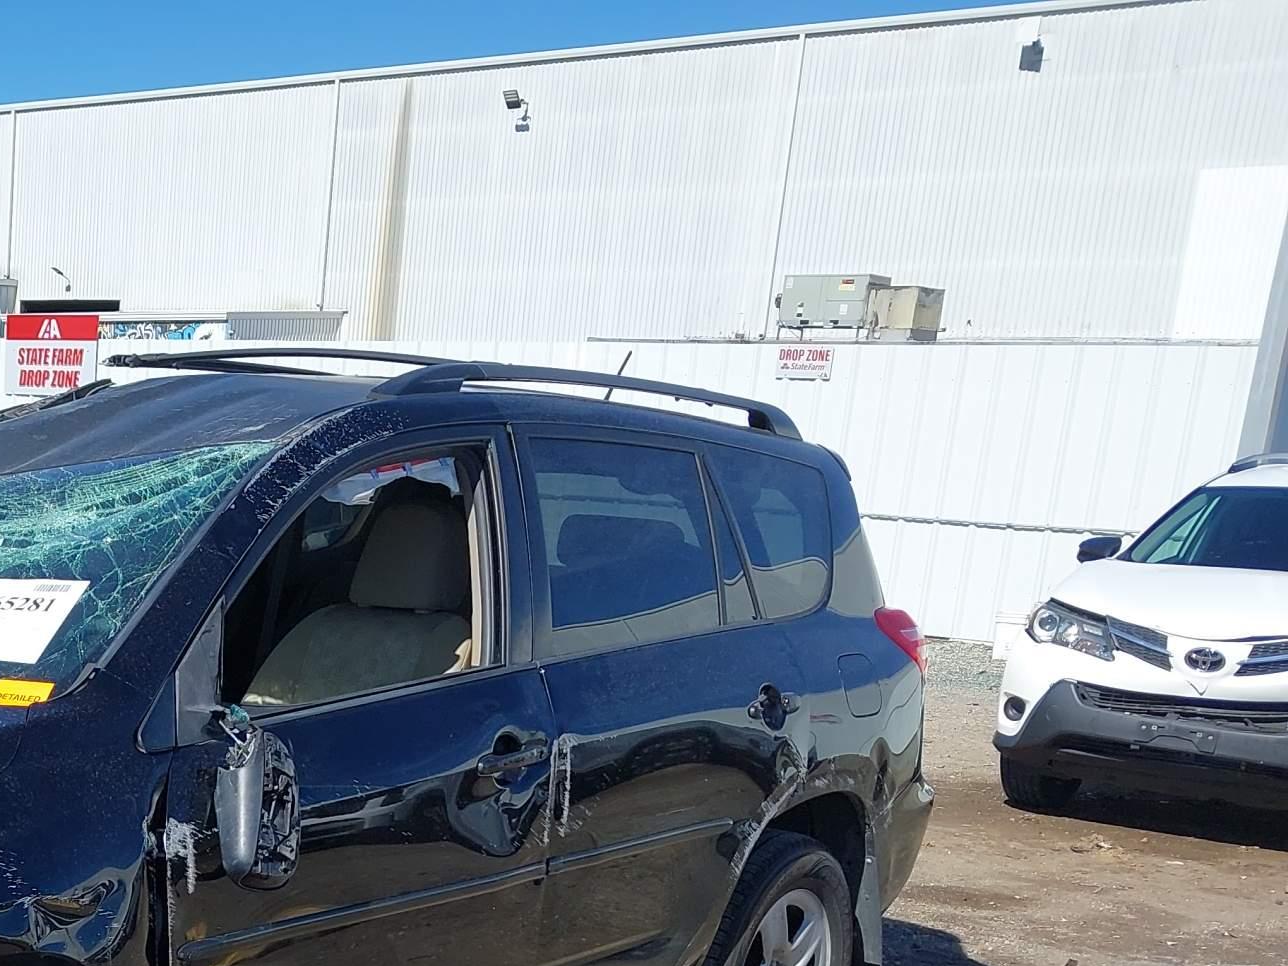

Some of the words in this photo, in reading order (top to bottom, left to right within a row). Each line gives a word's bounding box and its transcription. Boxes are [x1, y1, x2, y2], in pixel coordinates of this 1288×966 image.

[17, 347, 50, 366] STATE
[51, 348, 84, 367] FARM
[779, 348, 805, 361] DROP
[806, 349, 831, 362] ZONE
[19, 369, 50, 387] DROP
[50, 370, 81, 389] ZONE
